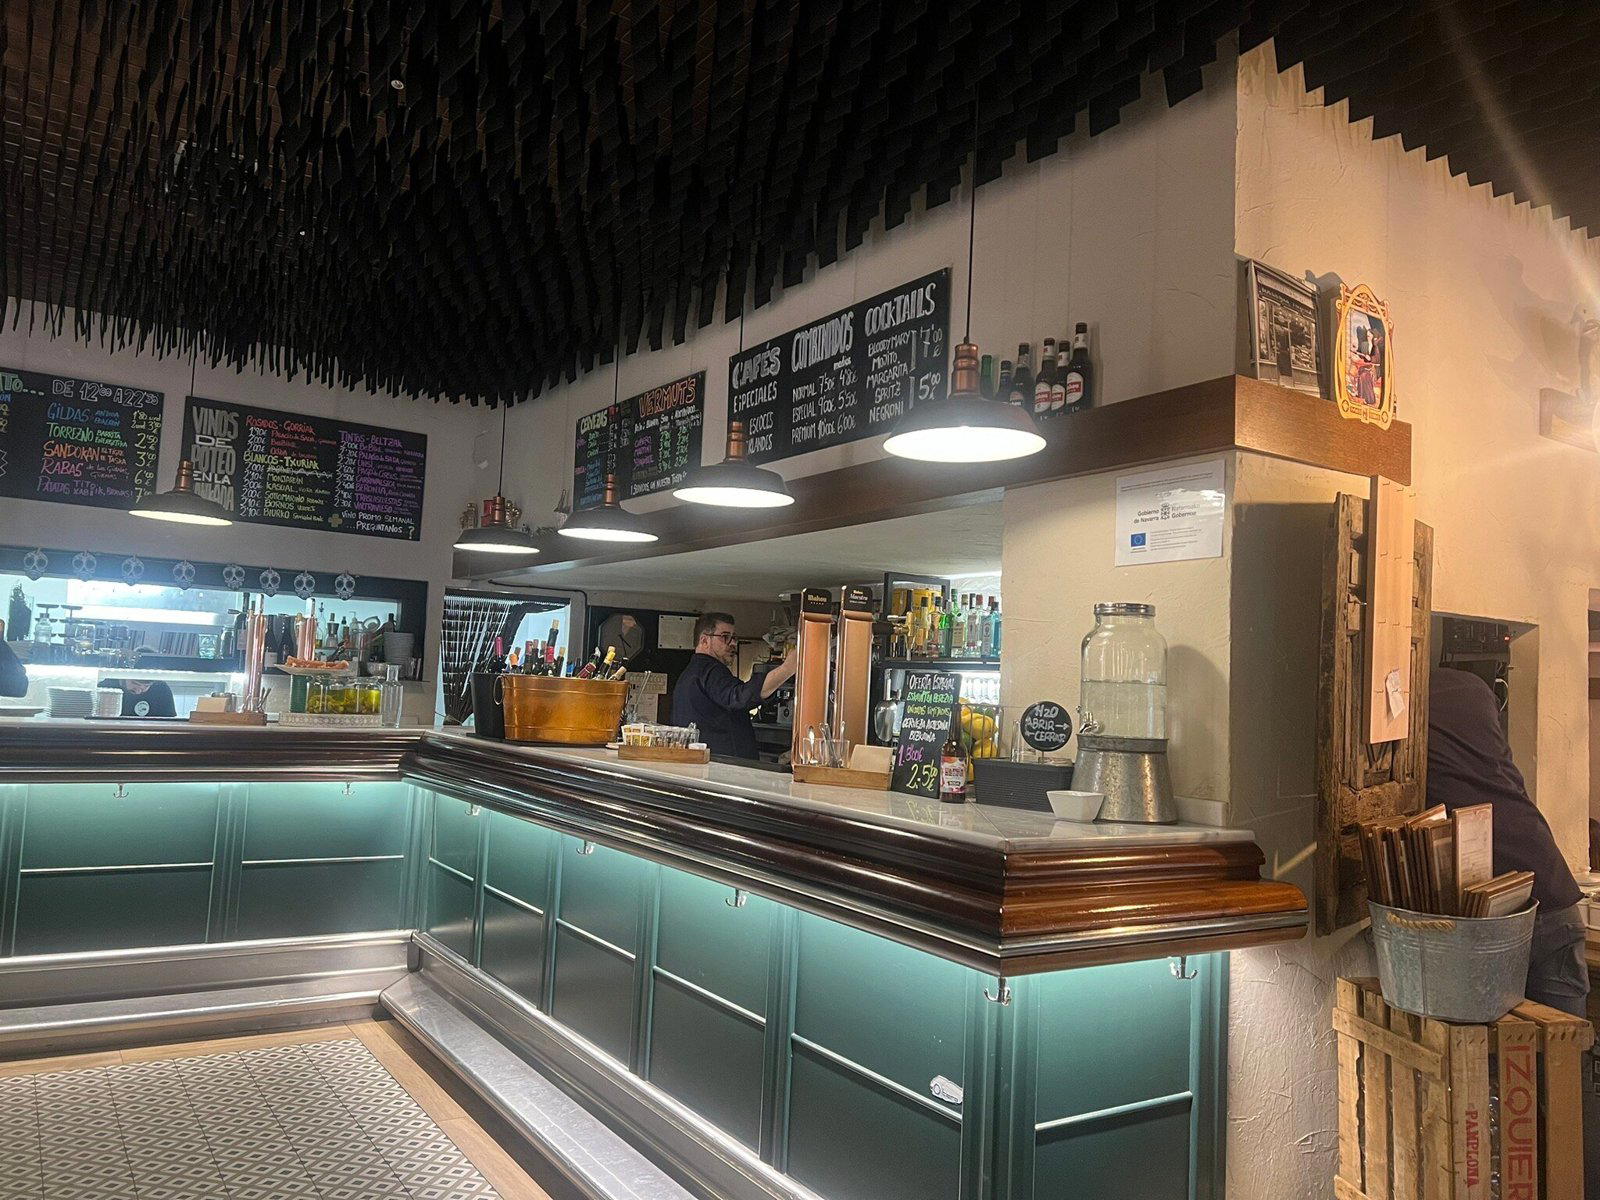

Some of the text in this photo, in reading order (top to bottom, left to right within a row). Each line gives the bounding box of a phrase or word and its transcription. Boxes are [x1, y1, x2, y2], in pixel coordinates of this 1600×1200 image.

[864, 282, 937, 337] COCKTAILS
[872, 352, 899, 372] MOJITO
[866, 362, 909, 389] MARGARITA
[52, 380, 75, 398] DE
[113, 388, 123, 404] A
[792, 383, 818, 403] NORMAL
[875, 382, 902, 404] SPRITZ
[192, 405, 239, 439] VINOS
[792, 402, 817, 423] ESPECIAL
[869, 401, 905, 423] NEGRONI
[46, 422, 94, 443] TORREZNO
[195, 434, 233, 449] DE
[43, 441, 101, 463] SANDOKAN
[190, 444, 237, 476] POTEO
[243, 449, 279, 465] BLANCOS
[283, 456, 320, 470] TXURIAK
[41, 458, 84, 478] RABAS
[193, 470, 231, 486] EN LA
[264, 499, 295, 510] BORNOS
[1137, 509, 1160, 517] Gobierno
[358, 511, 382, 522] PROMO
[384, 514, 415, 525] SEMANAL
[908, 673, 932, 691] OFERTA
[1025, 716, 1056, 732] ABRIR
[1465, 1110, 1480, 1189] PAMPLONA
